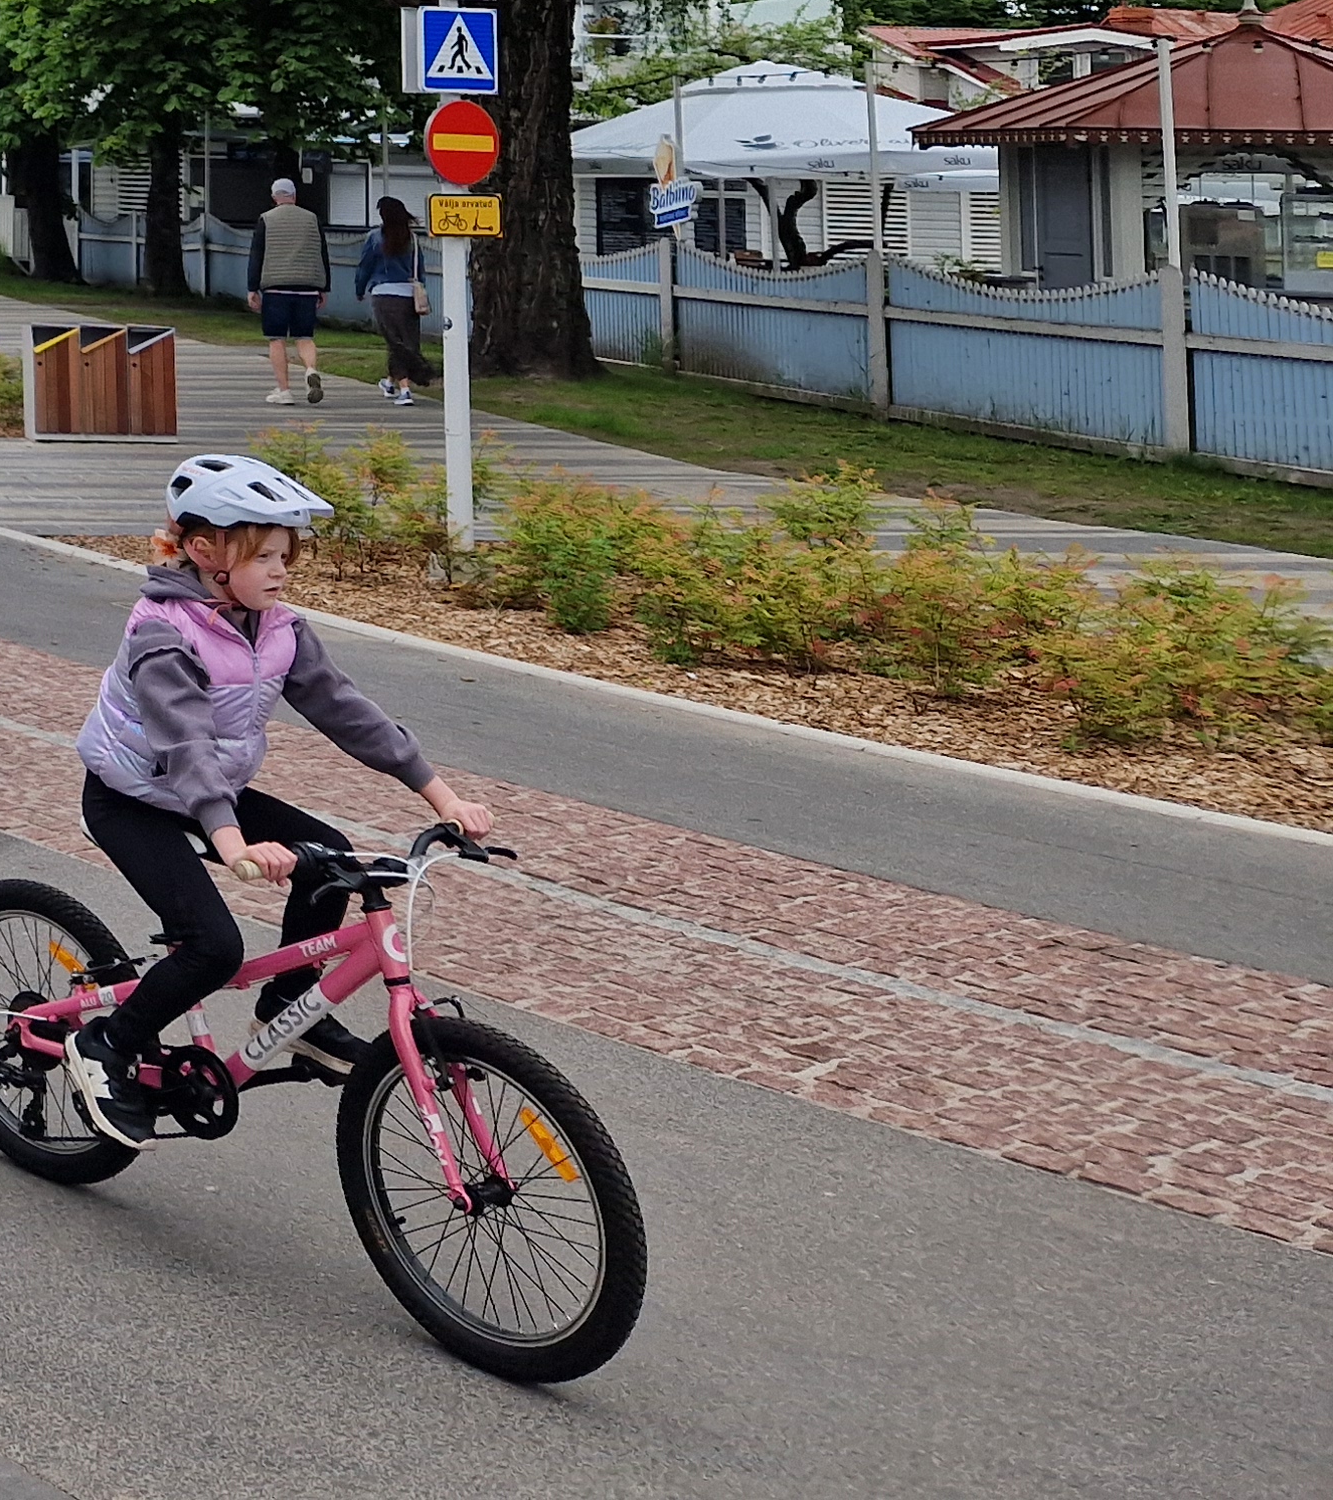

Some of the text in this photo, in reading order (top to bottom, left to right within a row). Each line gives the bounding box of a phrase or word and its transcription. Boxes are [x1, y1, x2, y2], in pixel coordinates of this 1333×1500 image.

[807, 158, 835, 169] saku
[943, 155, 971, 166] saku
[903, 178, 929, 188] saku
[650, 180, 696, 211] Balbiino
[438, 198, 459, 209] Välja
[298, 935, 337, 958] TEAM
[100, 990, 114, 1006] 20
[245, 988, 322, 1062] CLASSIC
